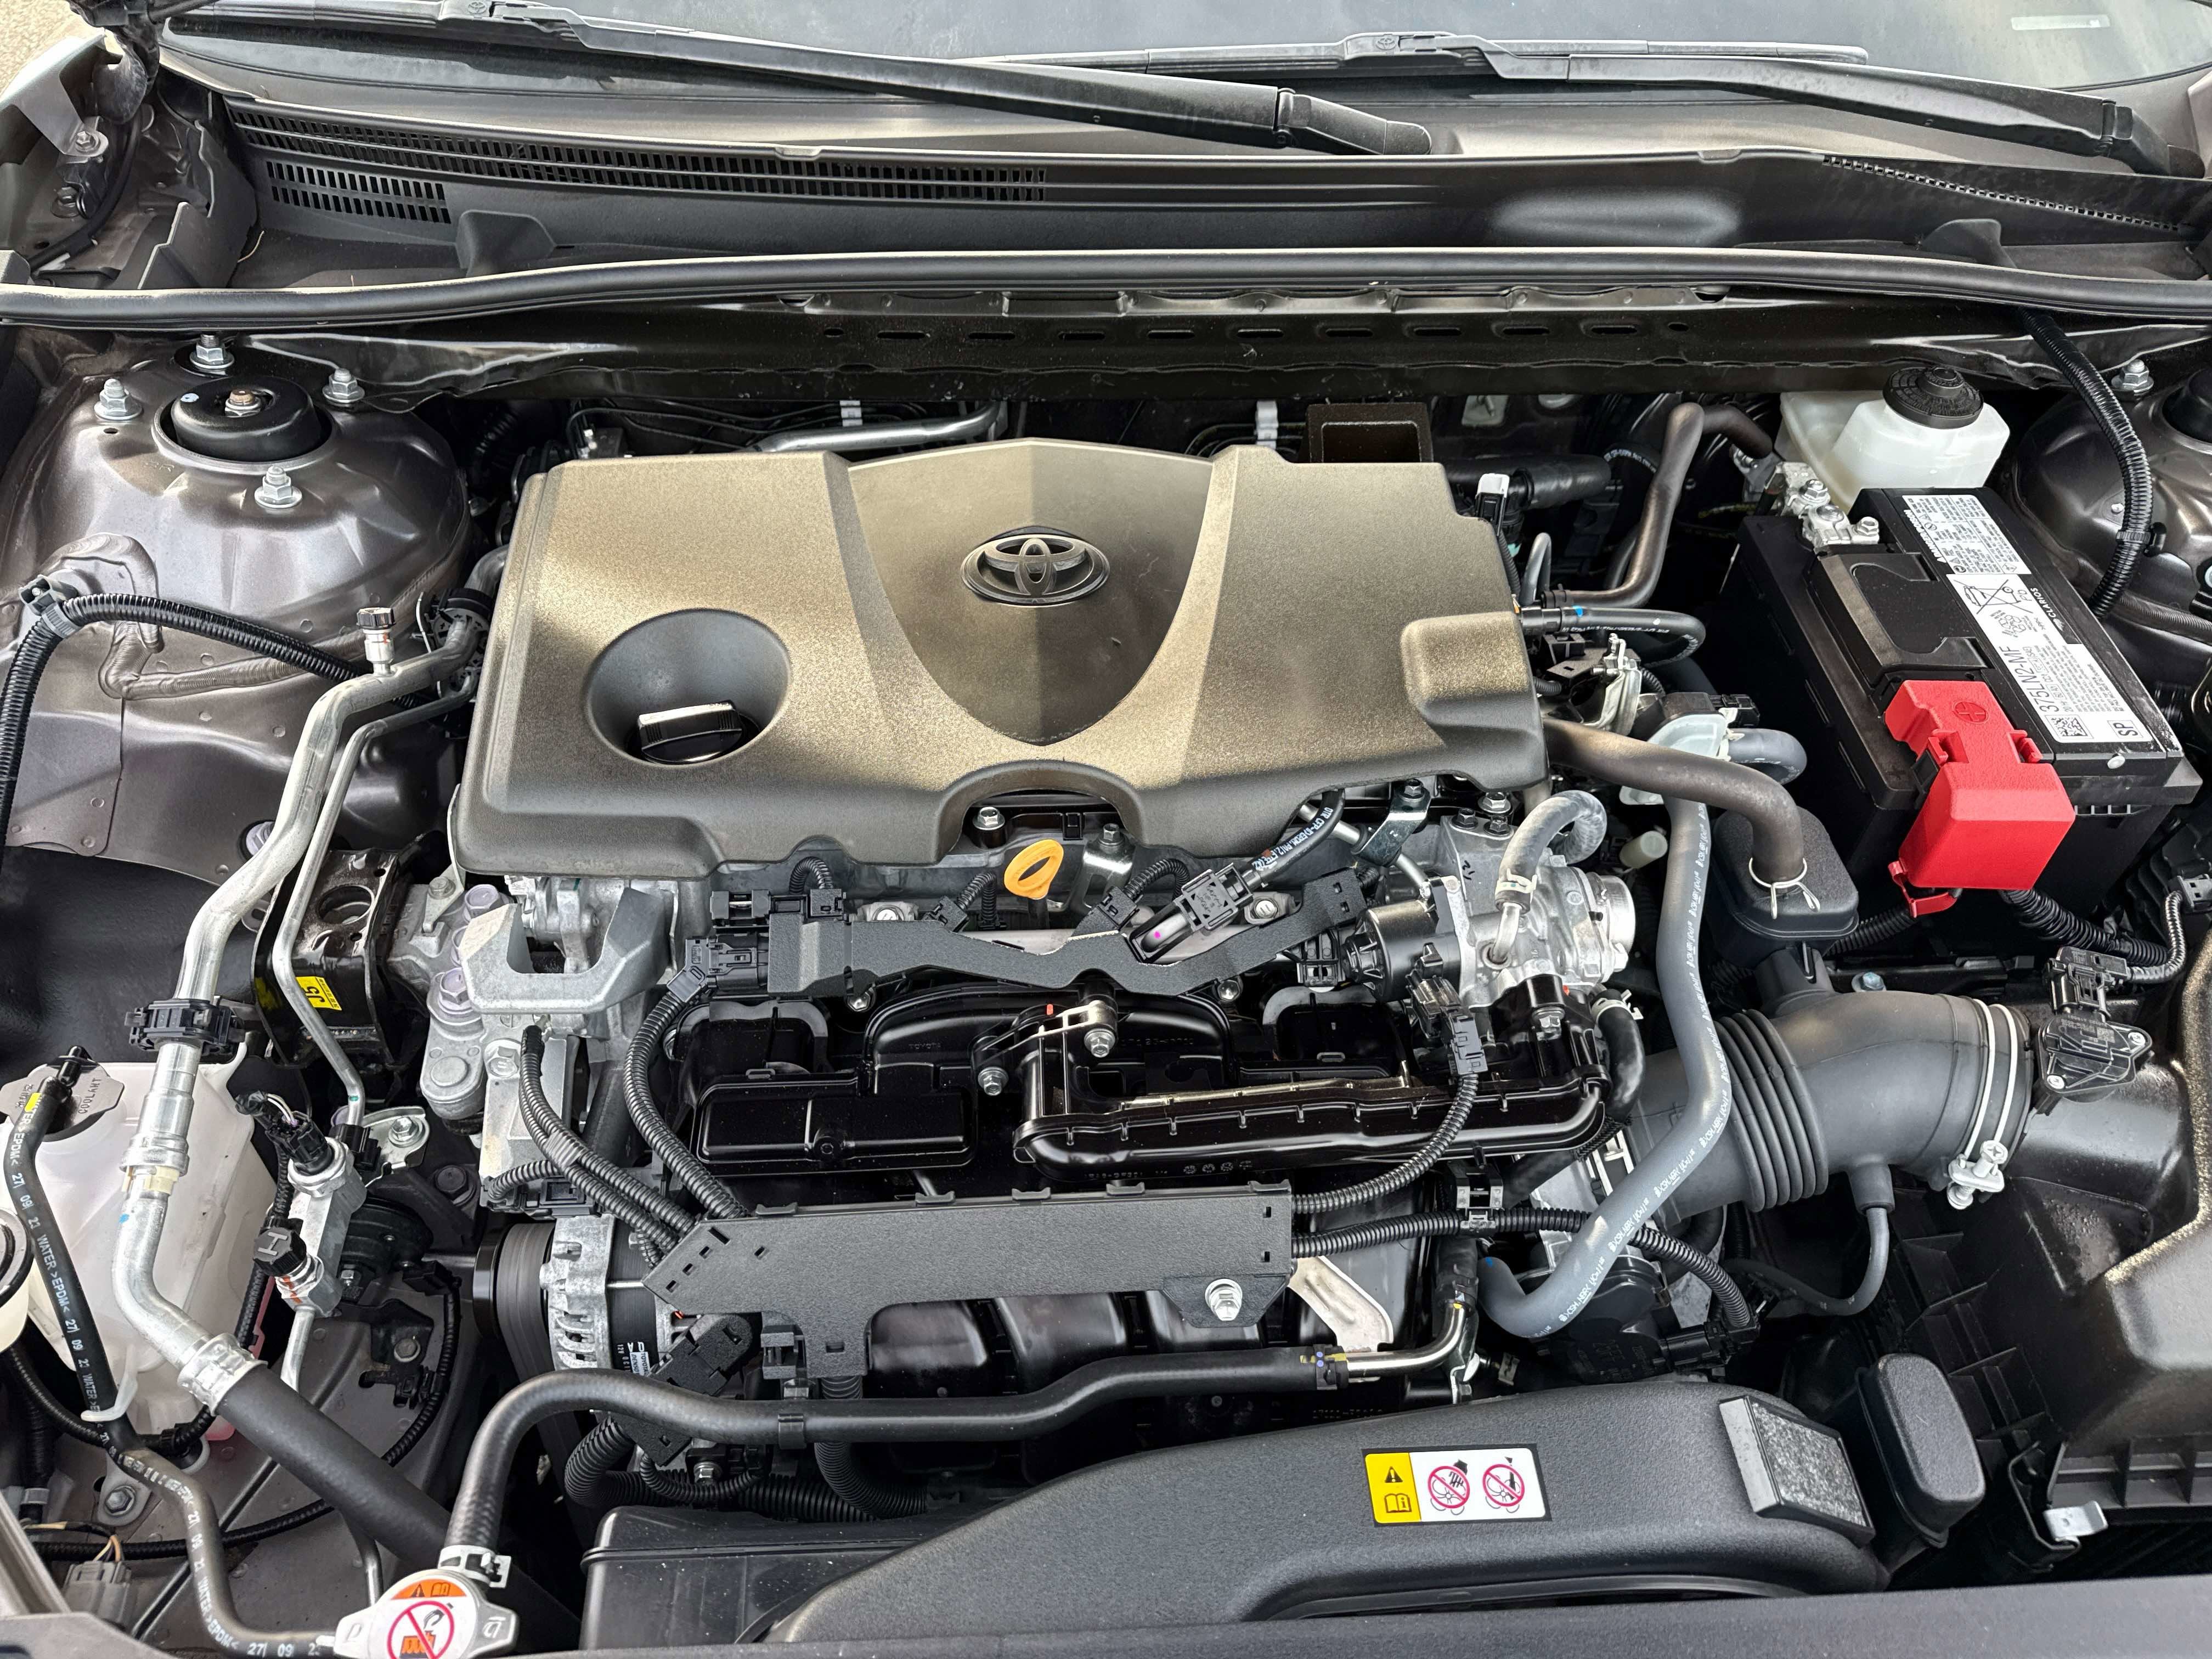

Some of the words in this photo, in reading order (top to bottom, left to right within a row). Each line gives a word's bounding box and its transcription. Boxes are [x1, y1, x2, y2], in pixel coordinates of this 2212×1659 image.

[2030, 587, 2056, 618] CLARIOS
[1999, 646, 2059, 713] 375LN2-MF
[2113, 722, 2138, 736] SP
[78, 1077, 101, 1114] COOLANT
[37, 1234, 57, 1271] WATER
[50, 1271, 70, 1313] >EPDM<
[631, 1353, 640, 1372] DENSO
[82, 1373, 98, 1404] WATER
